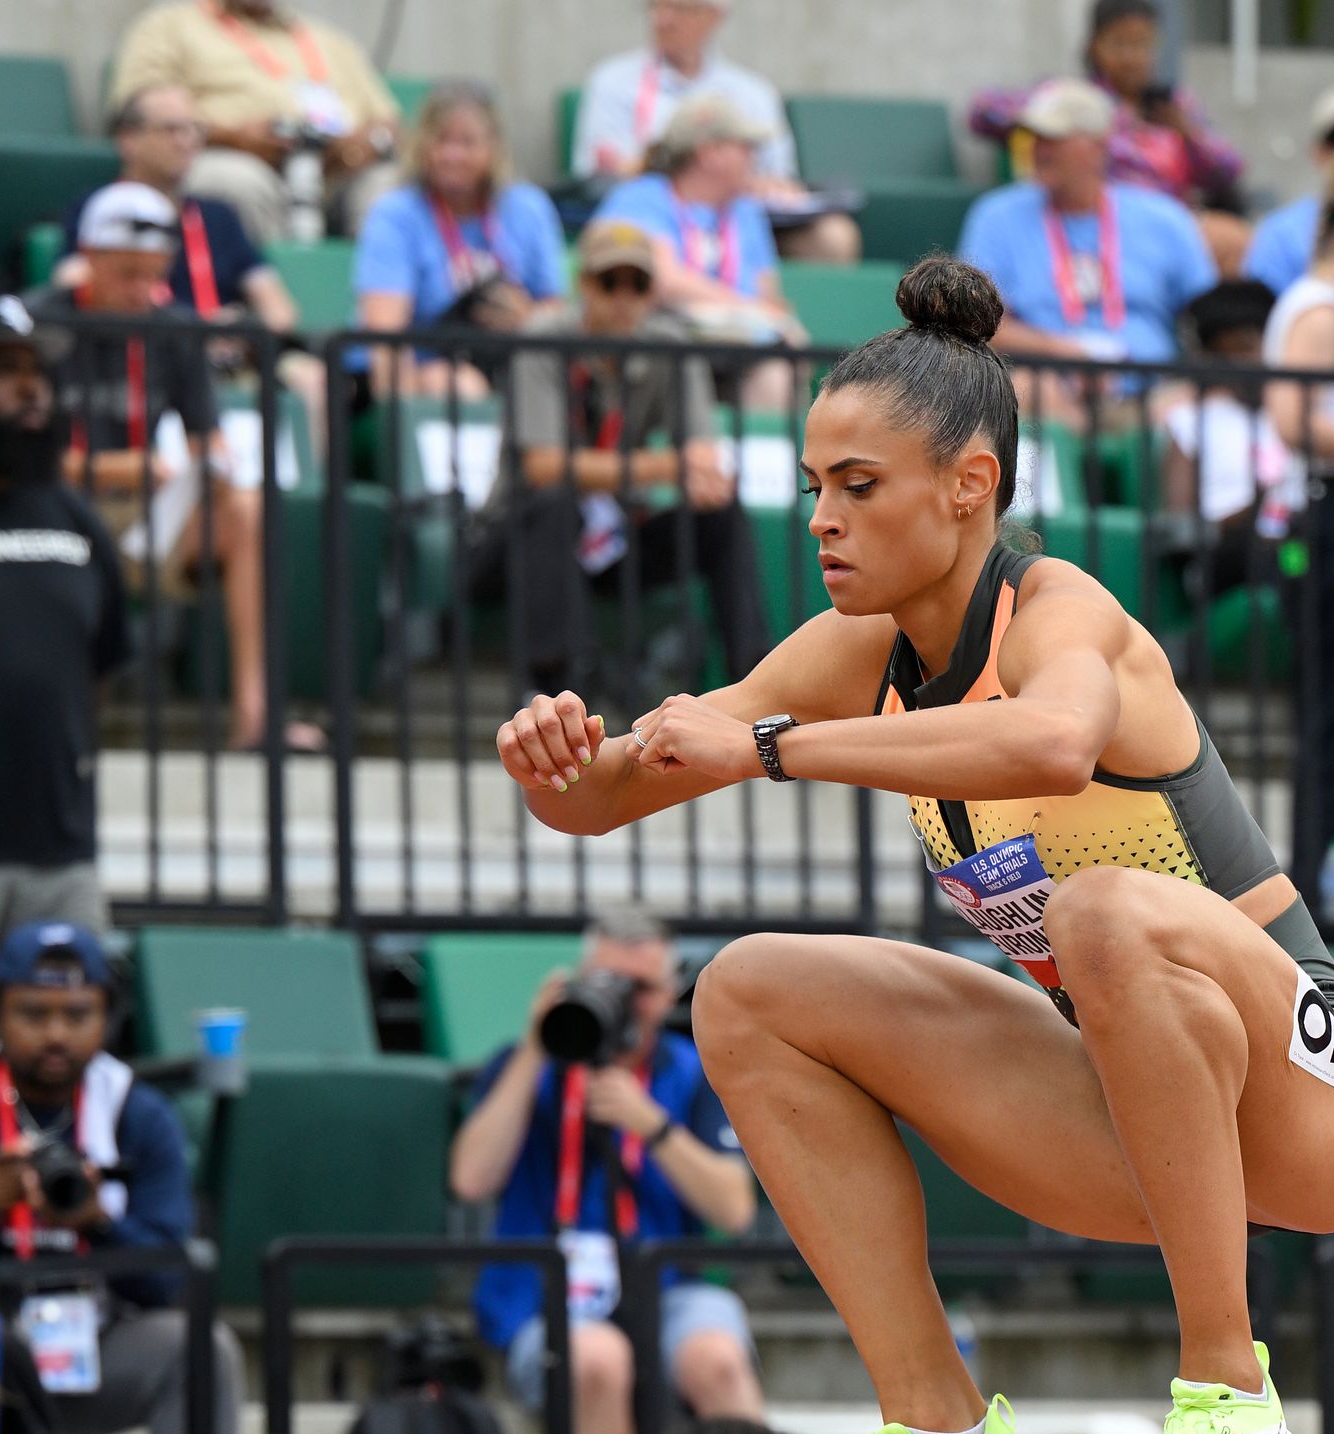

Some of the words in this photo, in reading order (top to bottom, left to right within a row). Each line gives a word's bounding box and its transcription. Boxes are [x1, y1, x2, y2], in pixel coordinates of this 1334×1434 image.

[971, 861, 990, 874] U.S.
[989, 842, 1023, 865] OLYMPIC
[978, 867, 1001, 886] TEAM
[999, 853, 1028, 875] TRIALS
[986, 879, 1002, 892] TRACK
[1007, 871, 1022, 884] FIELD
